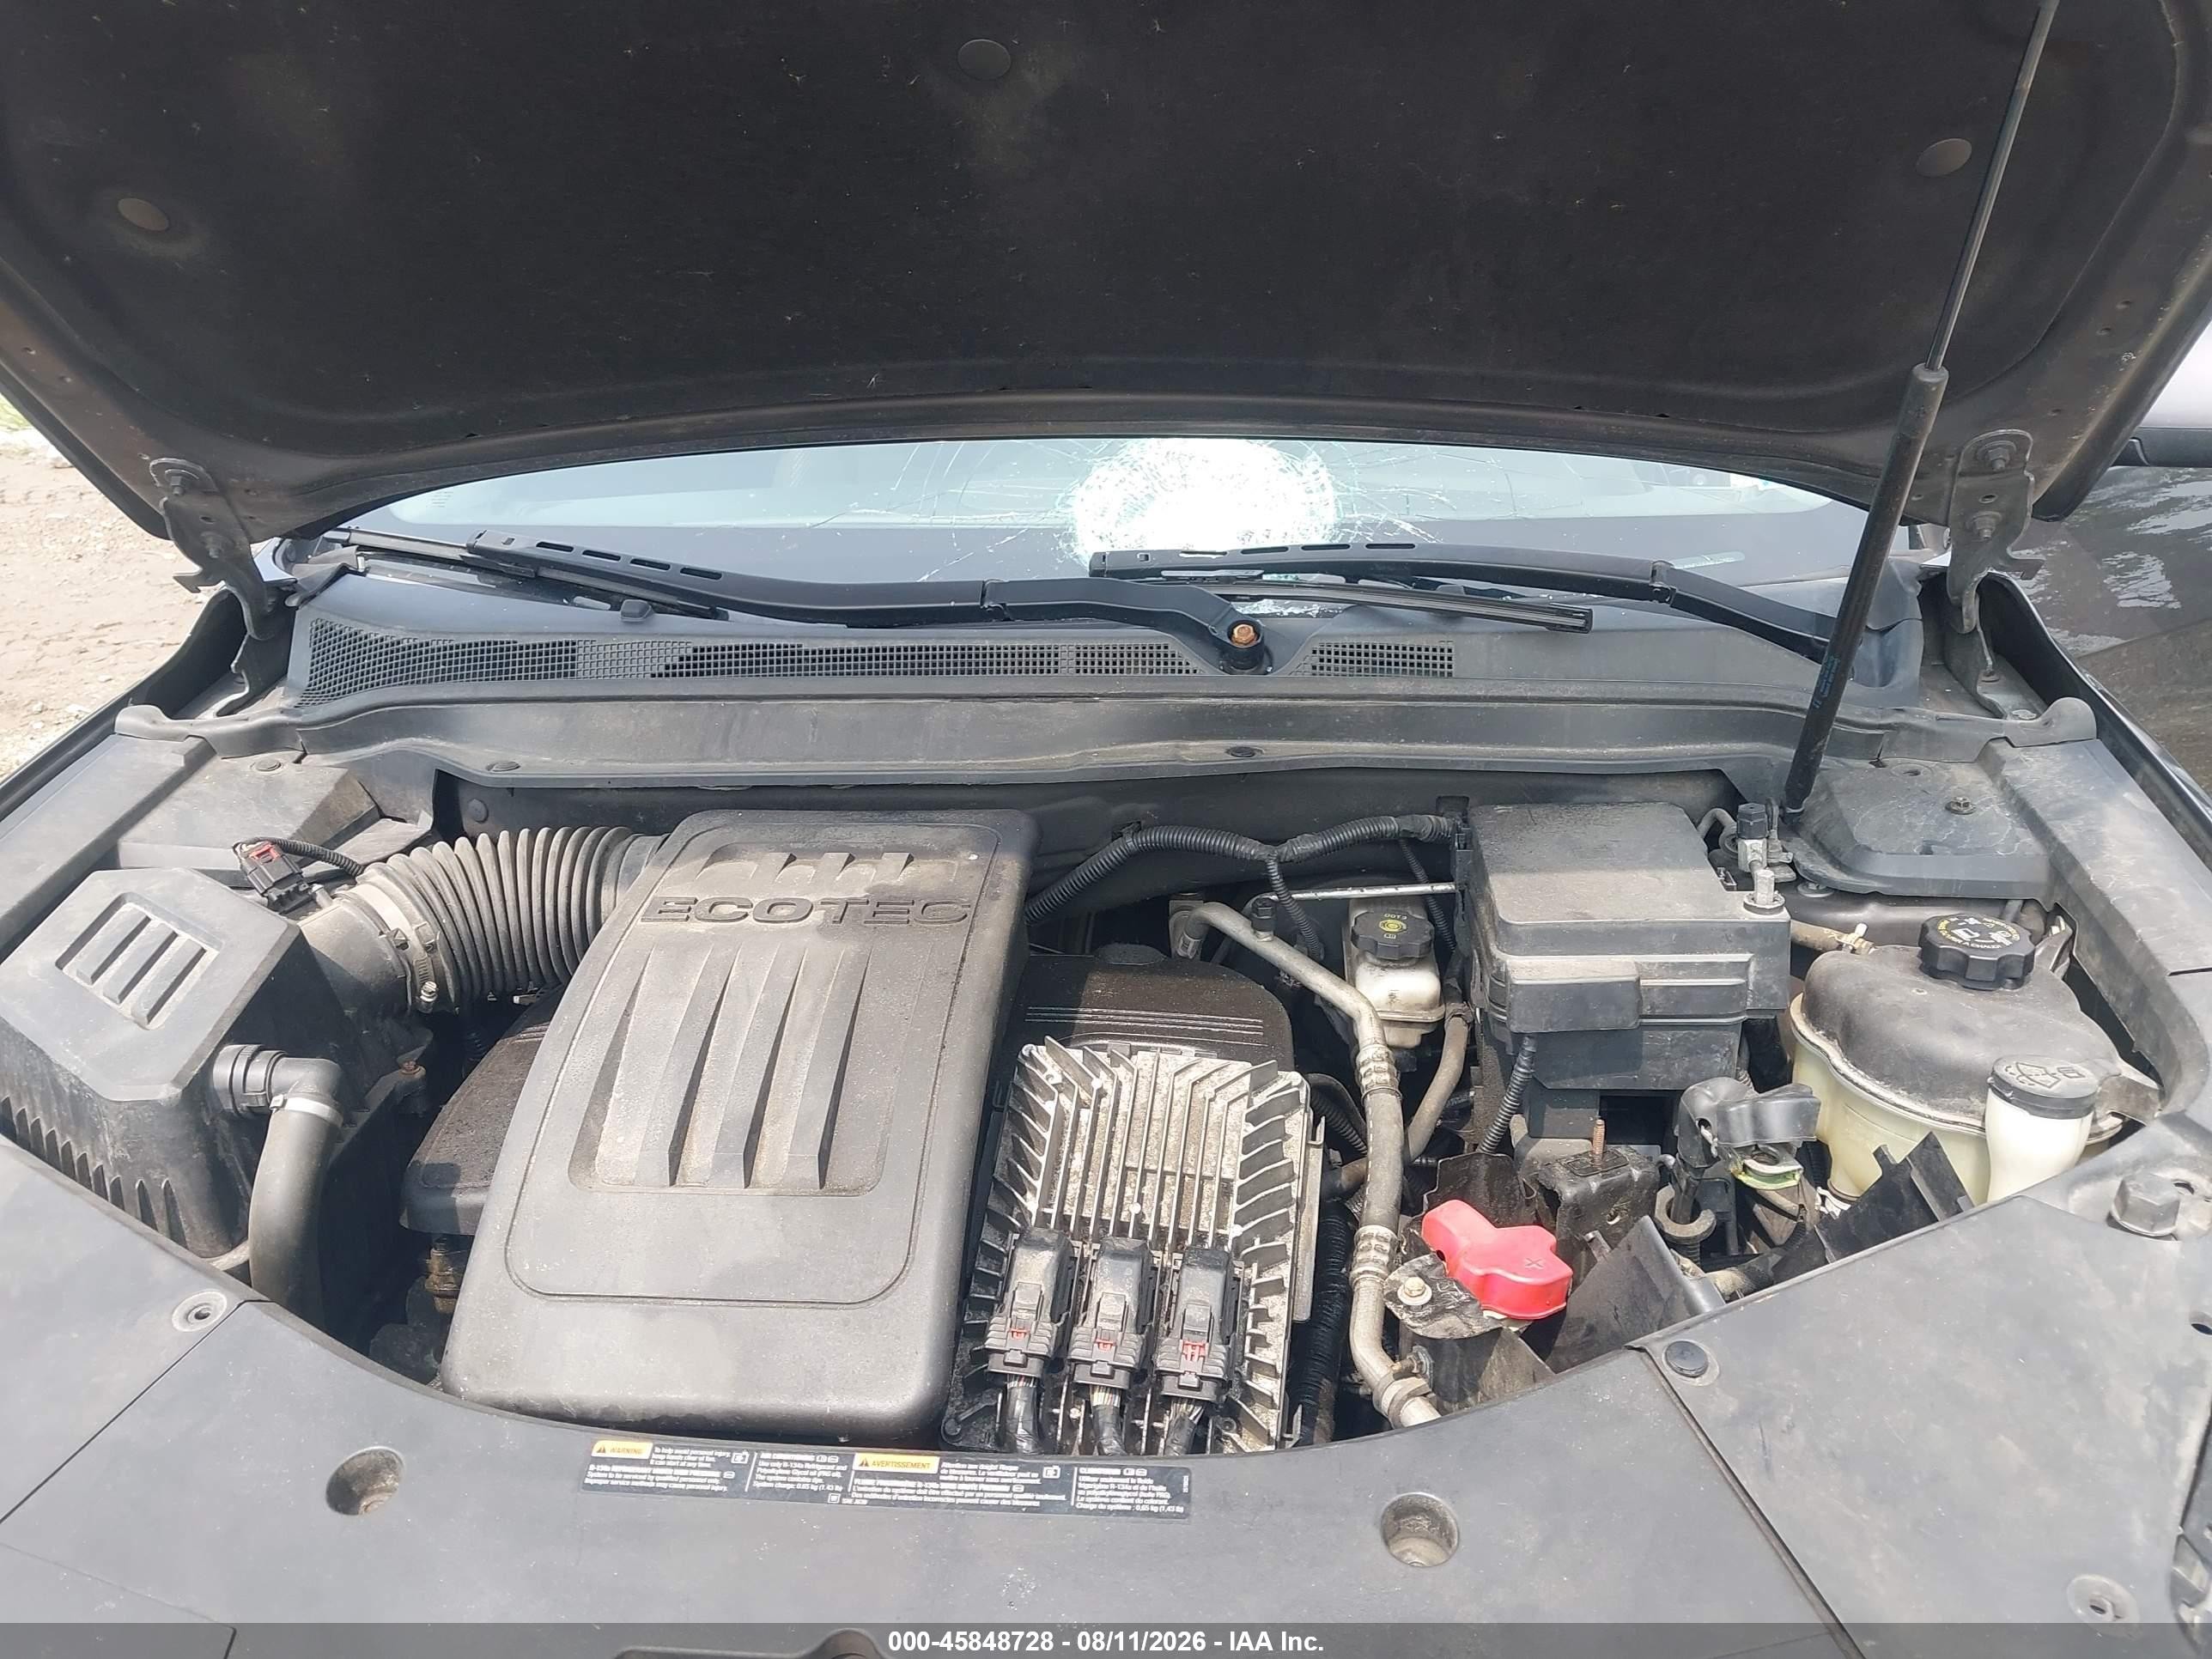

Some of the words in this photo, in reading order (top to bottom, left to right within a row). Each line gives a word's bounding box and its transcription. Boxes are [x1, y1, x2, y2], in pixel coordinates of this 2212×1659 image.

[641, 896, 971, 925] ECOTEC
[610, 1447, 644, 1455] WARNING
[872, 1460, 931, 1469] AVERTISSEMENT
